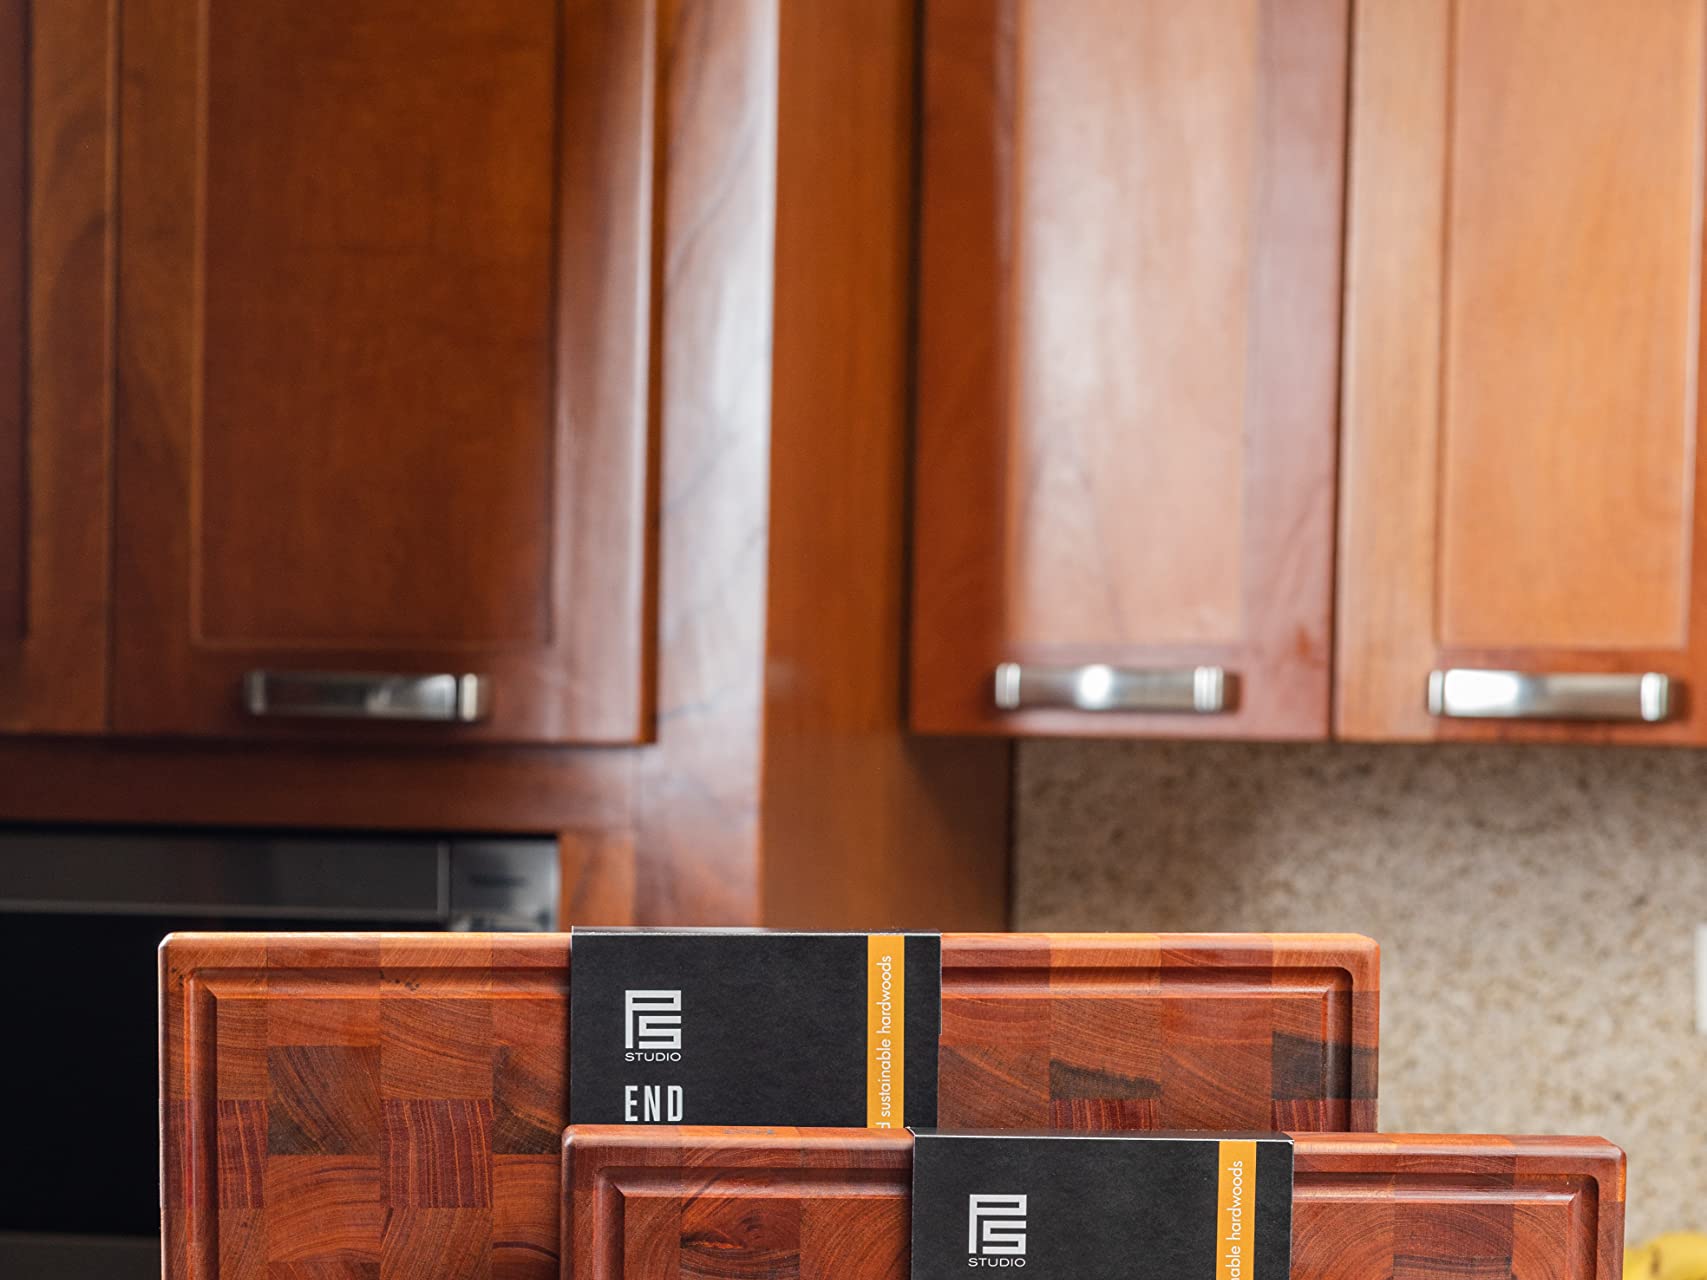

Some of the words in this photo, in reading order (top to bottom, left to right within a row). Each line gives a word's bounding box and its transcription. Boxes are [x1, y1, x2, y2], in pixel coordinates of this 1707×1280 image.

[877, 956, 892, 1033] hardwoods
[625, 1052, 681, 1061] STUDIO
[878, 1039, 891, 1117] sustainable
[625, 1086, 682, 1121] END
[1226, 1161, 1242, 1240] hardwoods
[968, 1258, 1025, 1267] STUDIO
